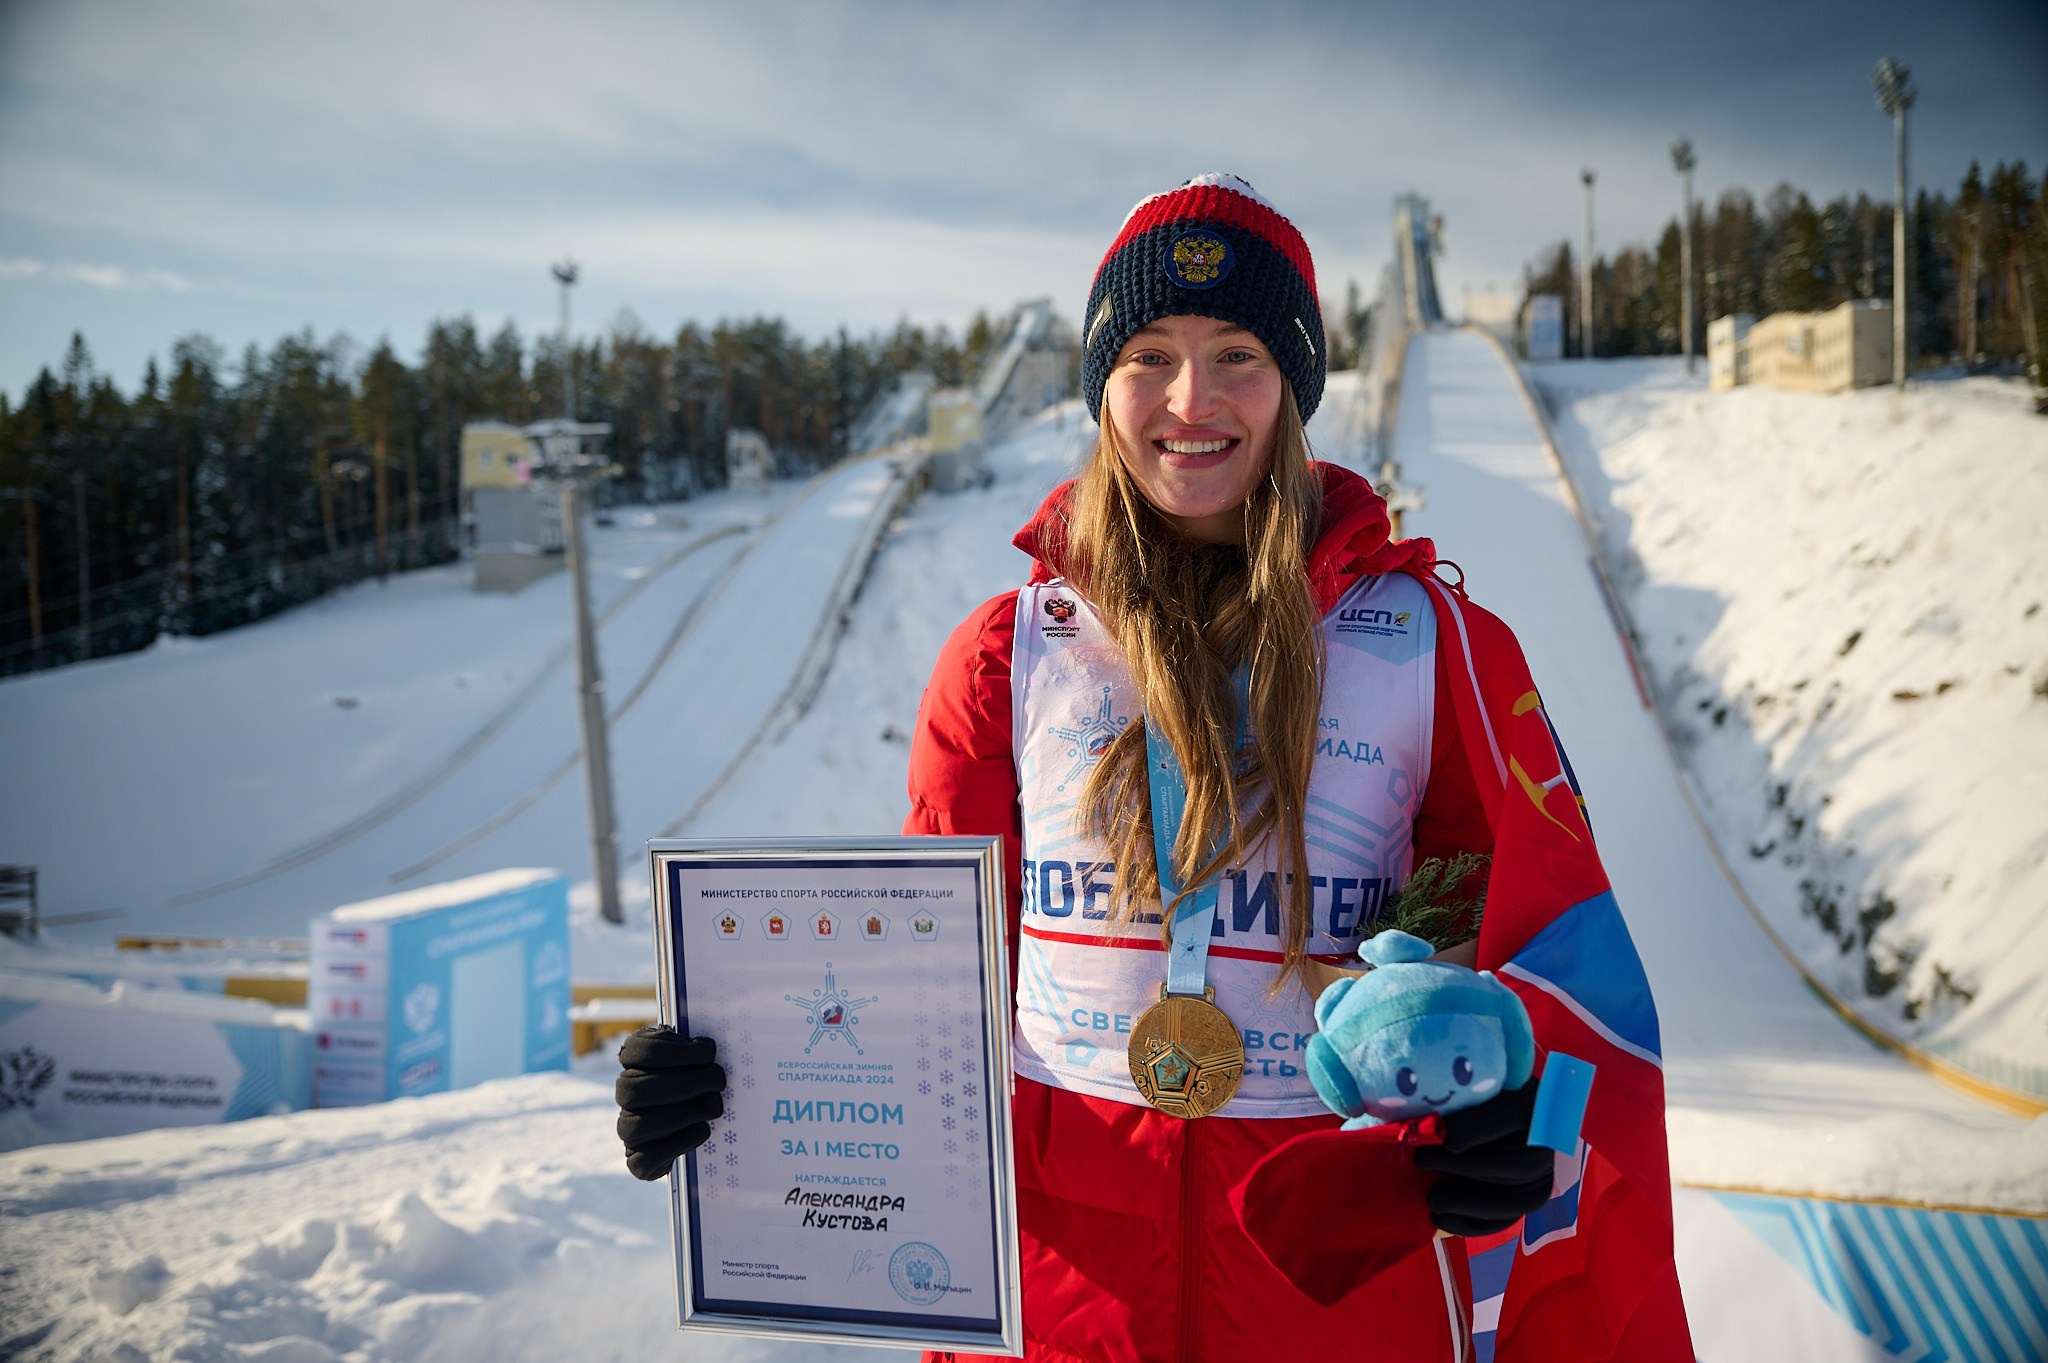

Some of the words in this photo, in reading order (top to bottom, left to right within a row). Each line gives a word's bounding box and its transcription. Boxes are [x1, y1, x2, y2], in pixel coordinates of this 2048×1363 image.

[1294, 317, 1306, 335] SKI
[1339, 609, 1393, 625] ЦСП
[1160, 786, 1170, 841] СПАРТАКИАДА
[701, 889, 778, 899] МИНИСТЕРСТВО
[780, 889, 818, 899] СПОРТА
[821, 888, 888, 899] РОССИЙСКОЙ
[890, 889, 954, 899] ФЕДЕРАЦИИ
[777, 1061, 854, 1071] ВСЕРОССИЙСКАЯ
[856, 1063, 893, 1071] ЗИМНЯЯ
[778, 1072, 863, 1084] СПАРТАКИАДА
[866, 1075, 894, 1084] 2024
[772, 1099, 904, 1125] ДИПЛОМ
[781, 1139, 808, 1156] ЗА
[826, 1141, 900, 1160] МЕСТО
[795, 1174, 887, 1187] НАГРАЖДАЕТСЯ
[722, 1260, 753, 1269] Министр
[754, 1262, 779, 1270] спорта
[722, 1269, 765, 1278] Российской
[765, 1272, 807, 1281] Федерации
[933, 1284, 972, 1293] Матыцин
